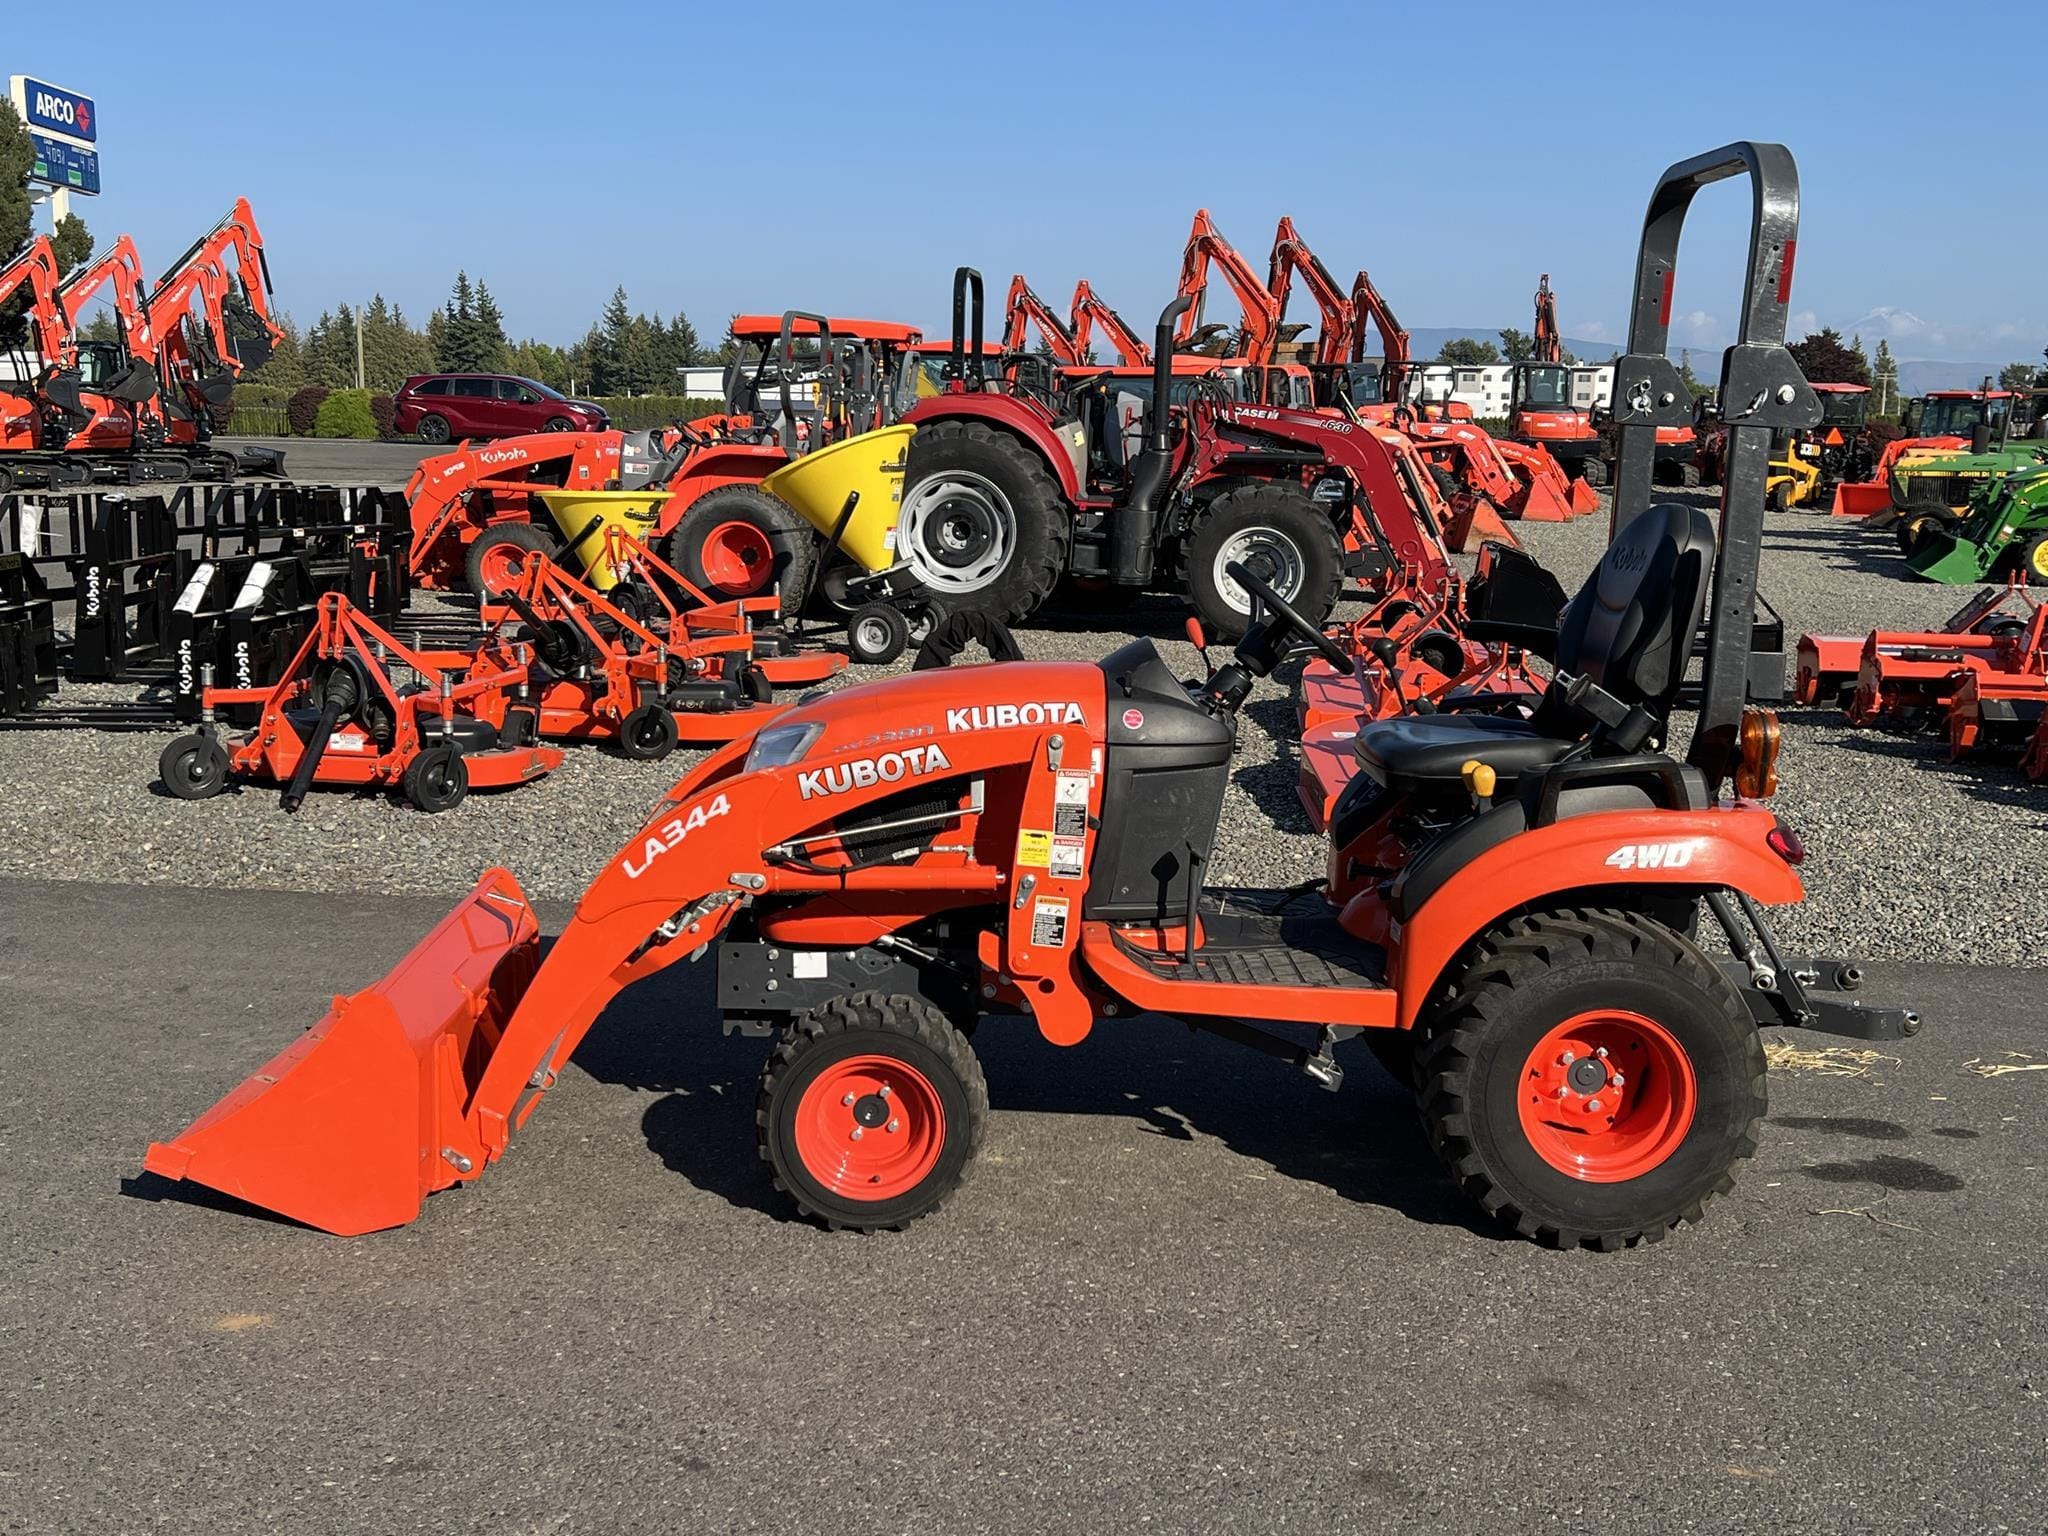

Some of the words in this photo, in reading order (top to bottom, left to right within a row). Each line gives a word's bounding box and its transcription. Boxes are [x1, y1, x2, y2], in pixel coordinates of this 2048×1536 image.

[36, 91, 74, 125] ARCO
[1235, 406, 1267, 419] CASE
[1320, 419, 1352, 434] L630
[480, 448, 527, 464] Kubota
[86, 566, 100, 616] Kubota
[178, 639, 193, 695] Kubota
[947, 702, 1087, 734] KUBOTA
[798, 743, 952, 801] KUBOTA
[622, 793, 731, 879] LA344
[1604, 843, 1695, 870] 4WD
